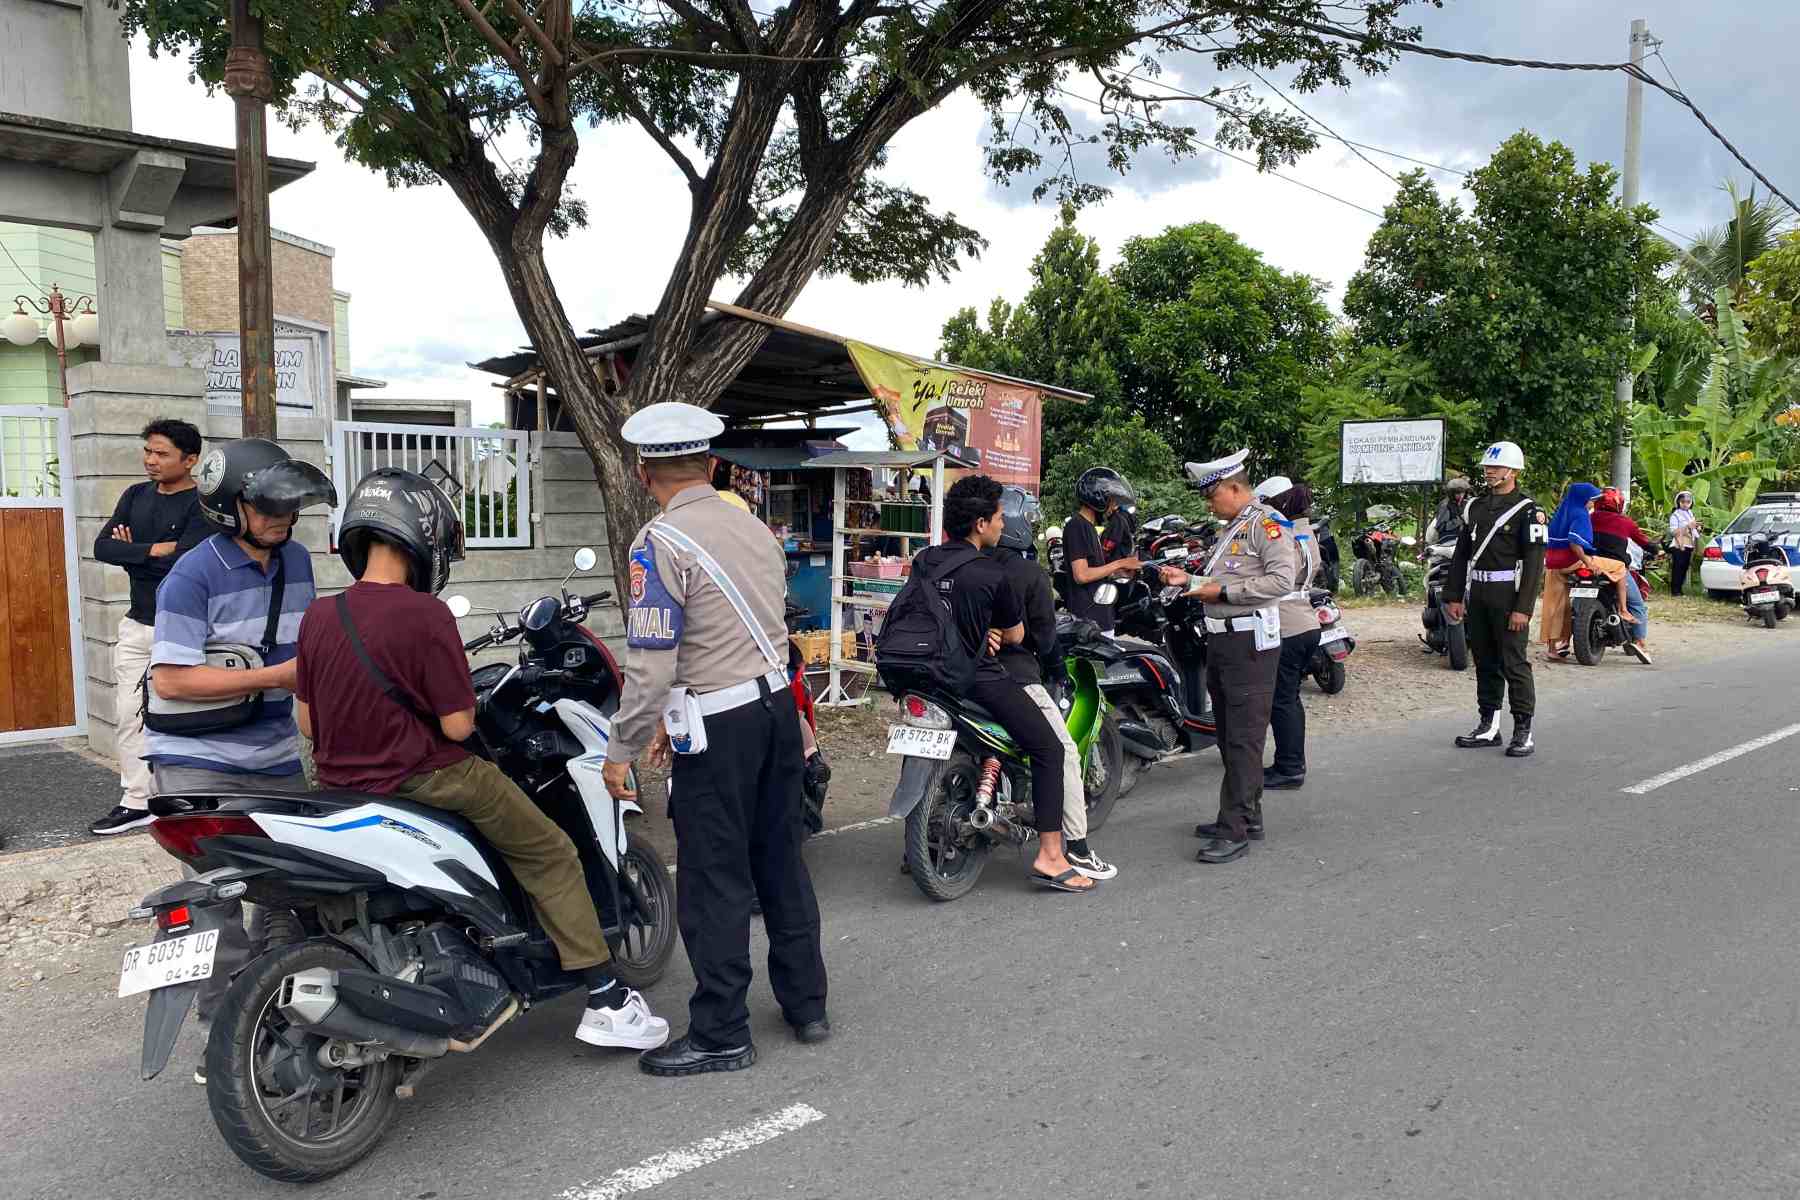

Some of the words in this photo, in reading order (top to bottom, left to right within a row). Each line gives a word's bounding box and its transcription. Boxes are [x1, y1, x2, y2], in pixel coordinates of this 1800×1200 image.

[949, 380, 988, 398] Rejeki
[945, 395, 985, 410] Umroh
[893, 728, 905, 740] DR
[907, 730, 934, 743] 5723
[123, 950, 140, 972] DR
[147, 938, 187, 965] 6035
[194, 932, 216, 954] UC
